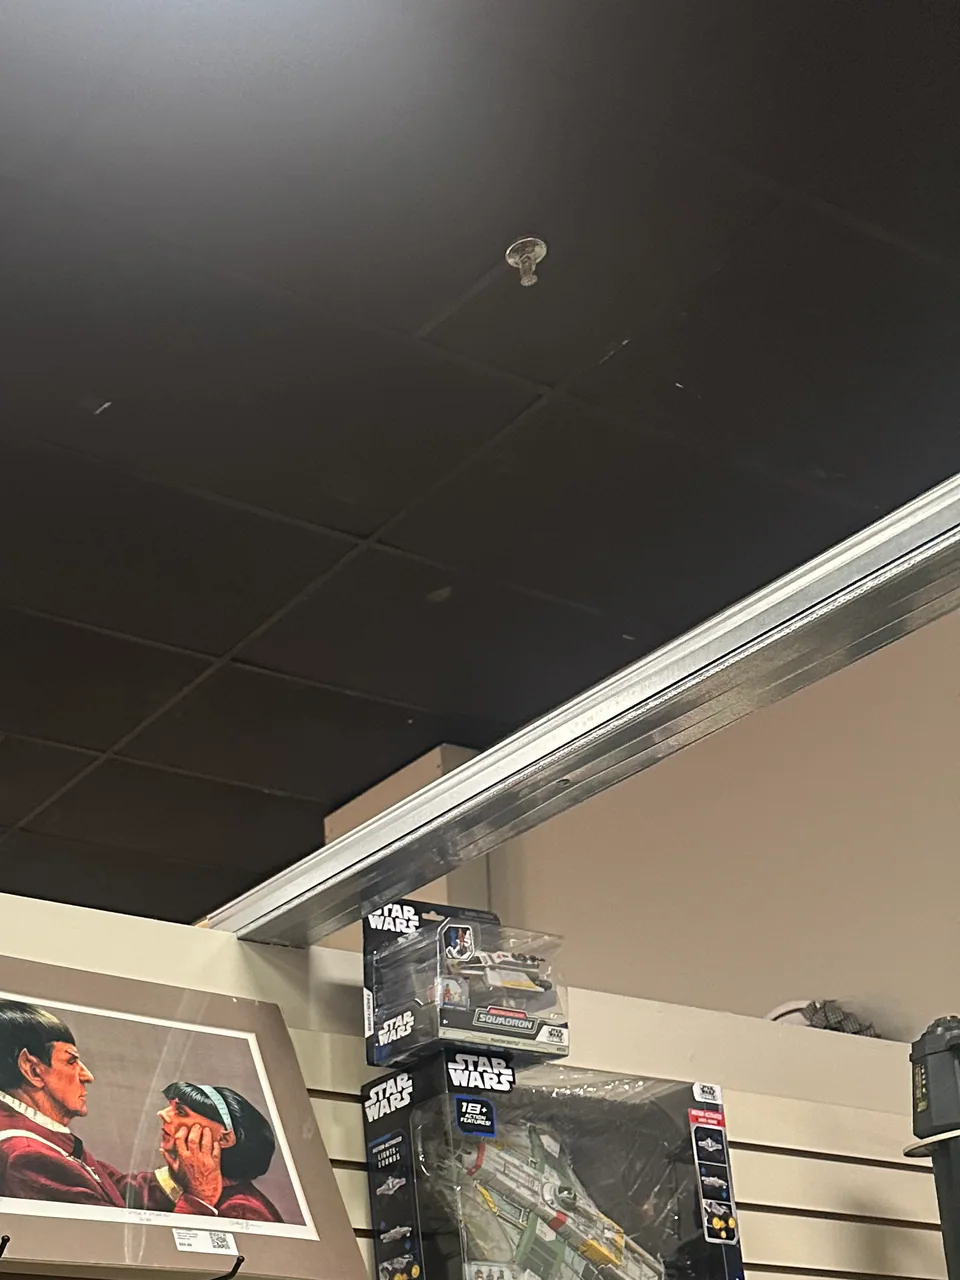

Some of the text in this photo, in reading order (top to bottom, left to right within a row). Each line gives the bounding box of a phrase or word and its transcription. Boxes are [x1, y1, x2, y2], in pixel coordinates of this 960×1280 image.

[368, 914, 419, 934] WARS
[378, 1010, 414, 1036] STAR
[479, 1013, 533, 1029] SQUADRON
[378, 1022, 414, 1047] WARS
[448, 1053, 512, 1075] STAR
[365, 1072, 412, 1108] STAR
[448, 1068, 514, 1091] WARS
[366, 1086, 413, 1122] WARS
[461, 1102, 487, 1114] 18+
